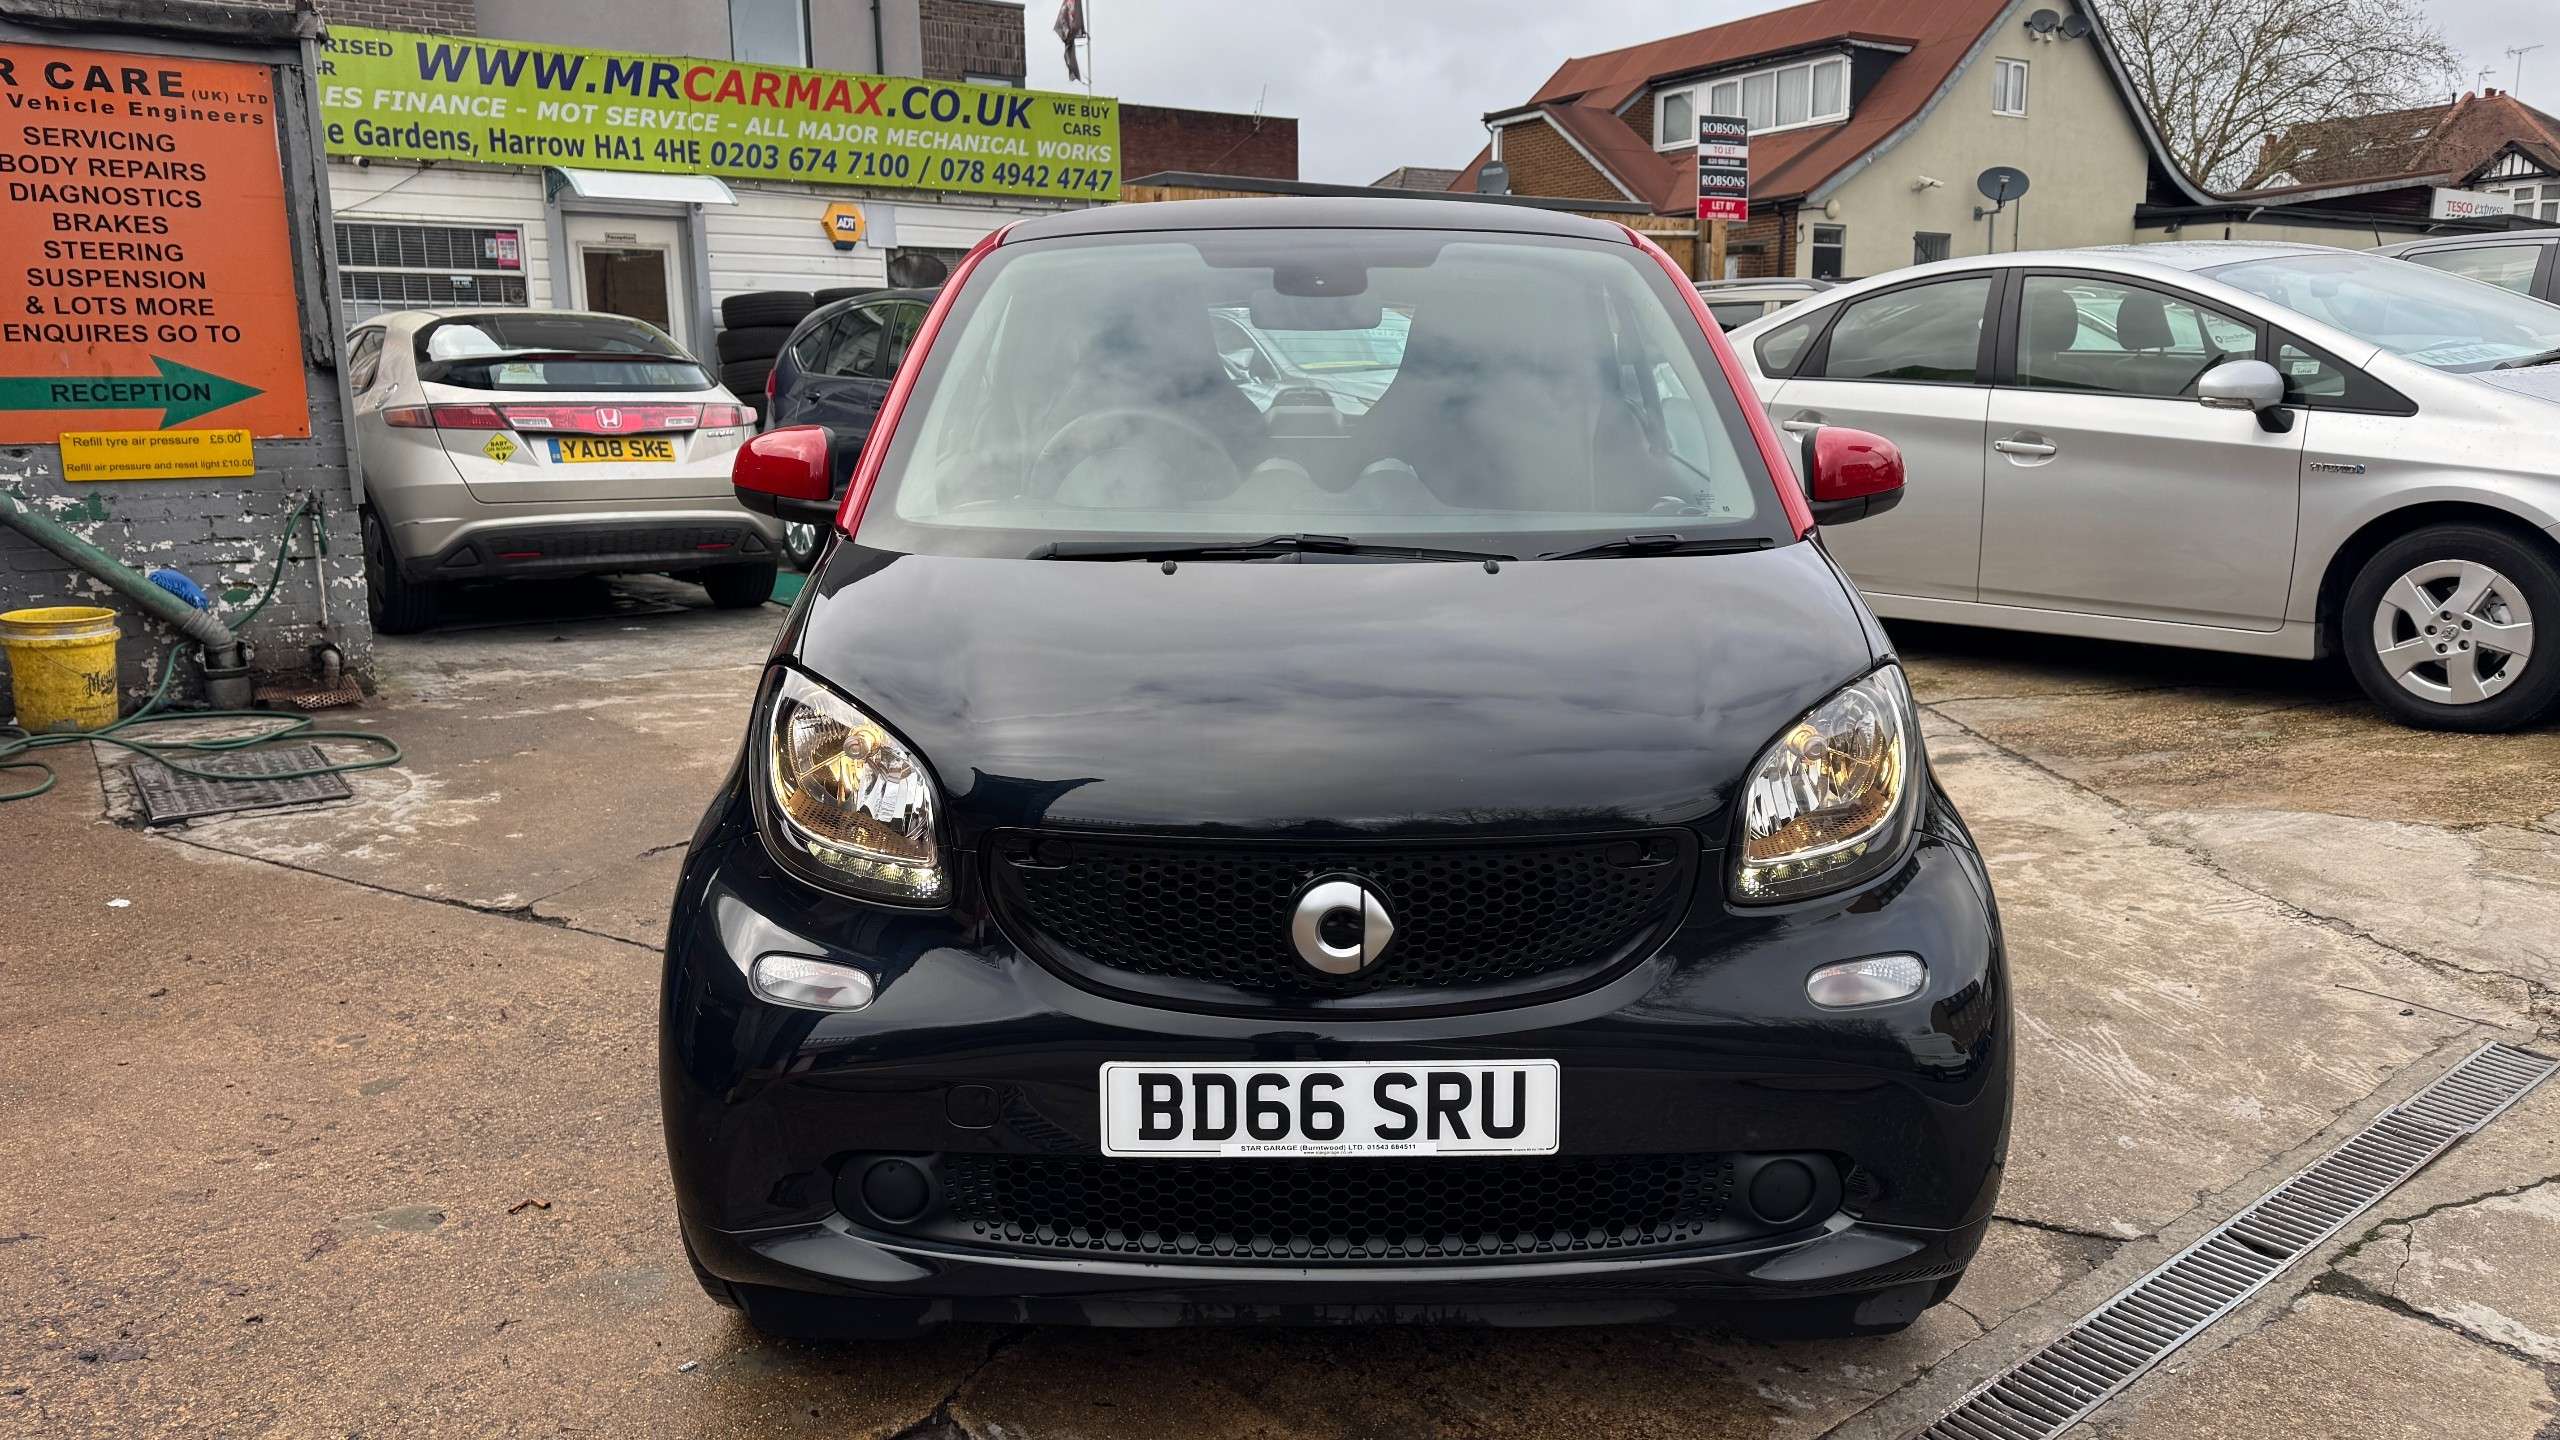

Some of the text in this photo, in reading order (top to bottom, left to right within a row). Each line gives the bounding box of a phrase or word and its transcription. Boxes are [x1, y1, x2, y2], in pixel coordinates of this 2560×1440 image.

[321, 38, 393, 57] RISED
[44, 61, 185, 98] CARE
[191, 89, 229, 104] (UK)
[238, 93, 268, 105] LTD
[416, 41, 1035, 130] WWW.MRCARMAX.CO.UK
[6, 93, 264, 125] Vehicle Engineers
[1053, 101, 1110, 119] WE BUY
[320, 86, 362, 109] ES
[373, 88, 507, 119] FINANCE
[537, 101, 598, 124] MOT
[605, 105, 719, 133] SERVICE
[745, 117, 789, 138] ALL
[798, 121, 878, 144] MAJOR
[886, 127, 1029, 156] MECHANICAL
[1037, 140, 1112, 163] WORKS
[1063, 122, 1101, 137] CARS
[1702, 122, 1745, 135] ROBSONS
[23, 126, 176, 153] SERVICING
[323, 119, 1113, 192] e Gardens, Harrow HA1 4HE 0203 674 7100 / 078 4942 4747
[1714, 146, 1735, 155] TO LET
[0, 154, 206, 182] BODY REPAIRS
[1702, 175, 1745, 187] ROBSONS
[9, 183, 202, 208] DIAGNOSTICS
[1712, 201, 1736, 211] LET BY
[2446, 201, 2503, 216] TESCO express
[52, 212, 169, 235] BRAKES
[837, 216, 854, 230] ADT
[44, 240, 184, 262] STEERING
[27, 268, 206, 289] SUSPENSION
[25, 296, 215, 316] & LOTS MORE
[3, 323, 241, 343] ENQUIRES GO TO
[51, 383, 211, 402] RECEPTION
[72, 433, 241, 448] Refill tyre air pressure £5.00
[564, 439, 624, 459] YA08
[630, 438, 671, 459] SKE
[67, 459, 254, 473] Refill air pressure and reset light £10.00
[1138, 1070, 1526, 1141] BD66 SRU
